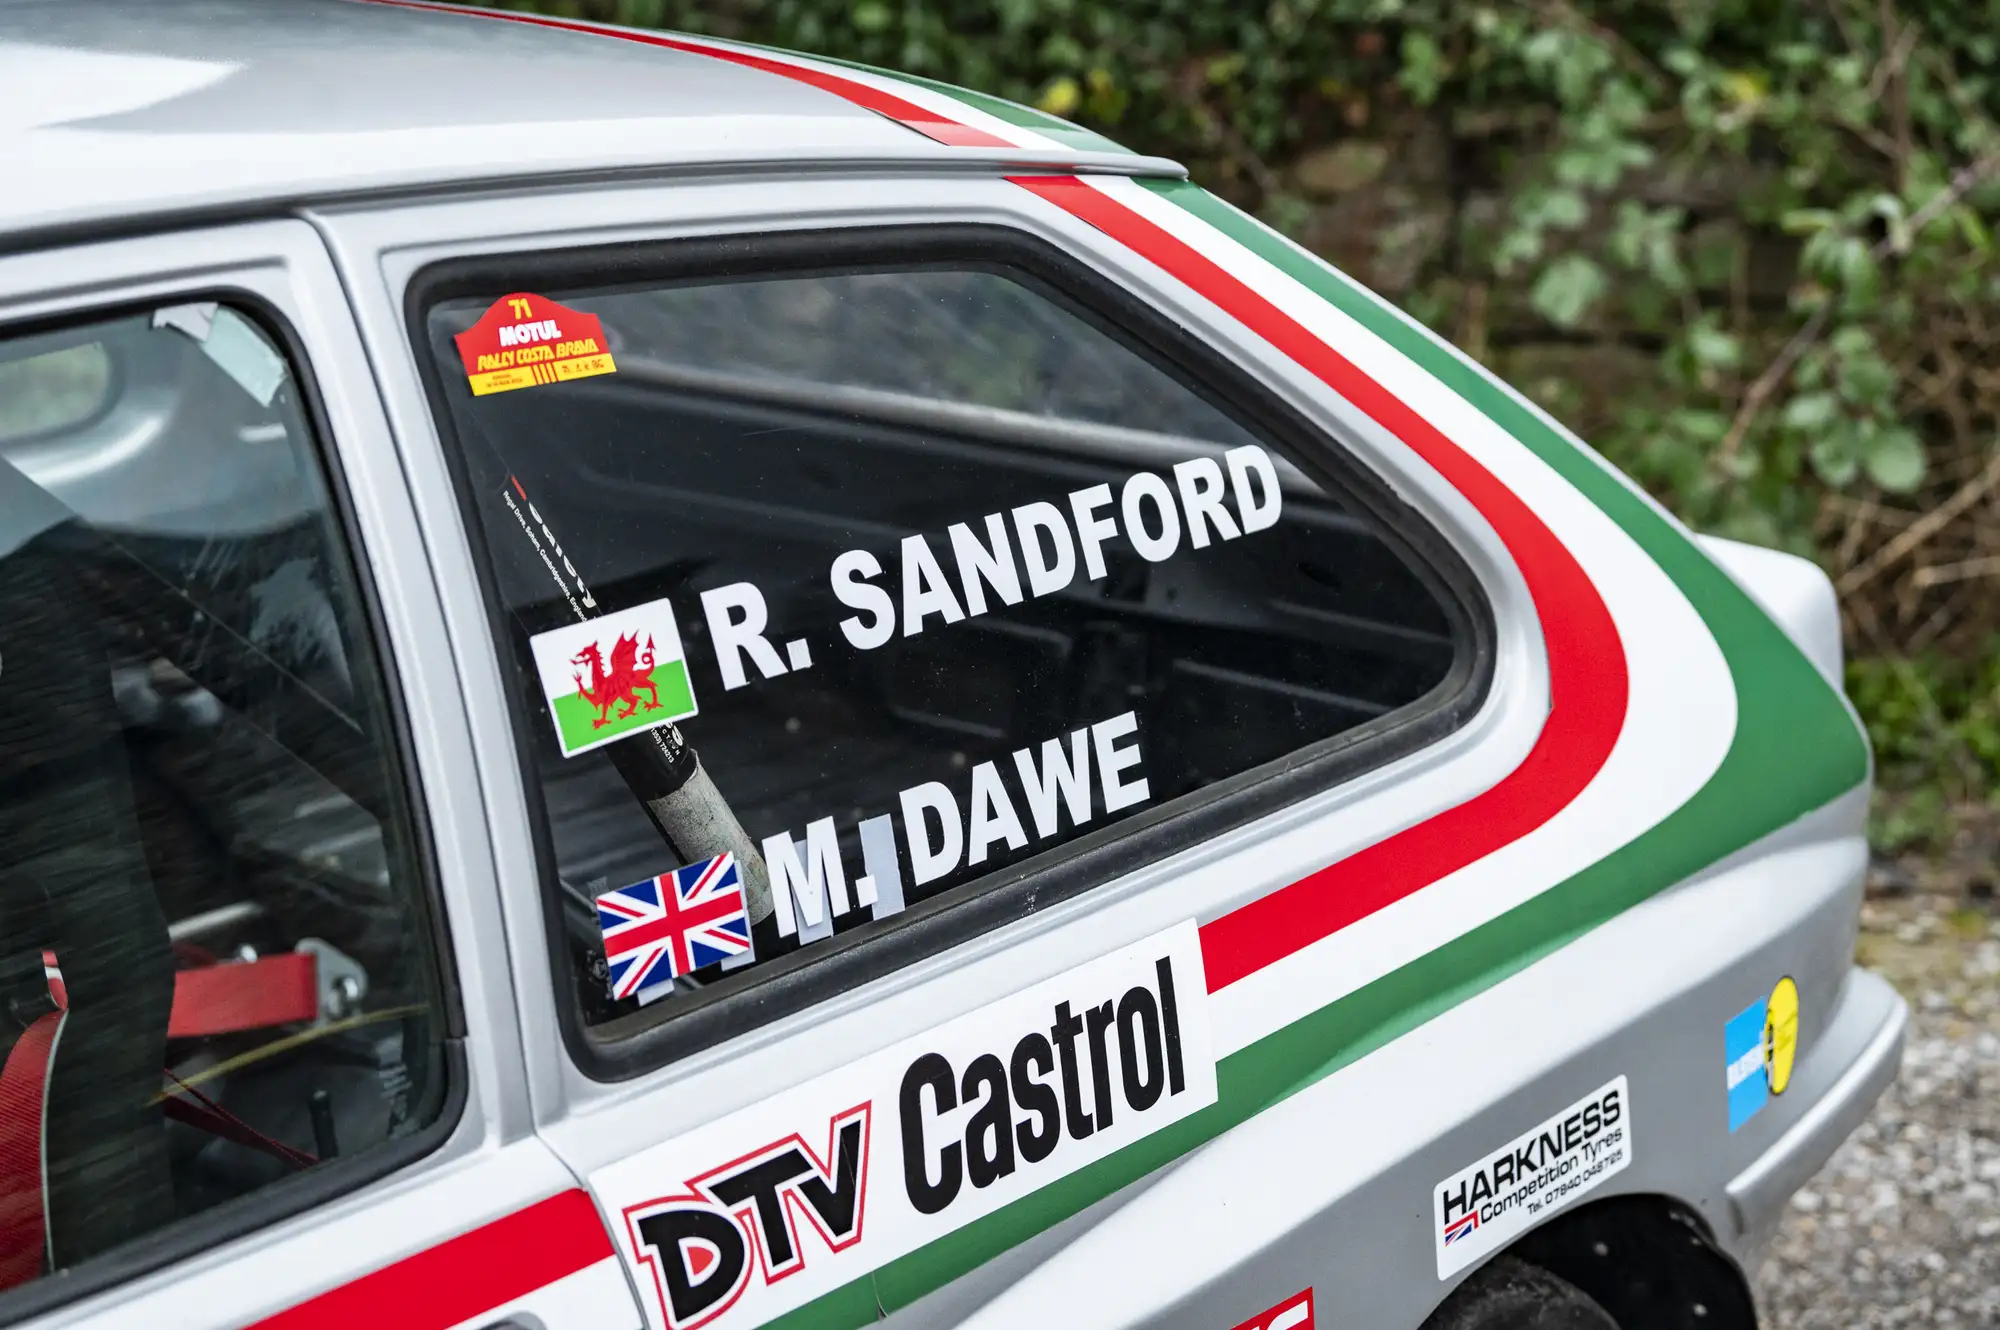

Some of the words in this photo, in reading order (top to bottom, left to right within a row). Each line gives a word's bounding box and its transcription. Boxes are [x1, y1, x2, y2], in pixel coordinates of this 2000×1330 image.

[498, 319, 562, 347] MOTUL
[508, 298, 533, 320] 71
[477, 349, 515, 372] RALLY
[515, 345, 555, 365] COSTA
[555, 338, 600, 359] BRAVA
[513, 507, 526, 529] Drive,
[524, 525, 541, 552] Soham,
[700, 581, 814, 692] R.
[829, 444, 1283, 651] SANDFORD
[760, 816, 879, 939] M.
[899, 710, 1150, 887] DAWE
[623, 1099, 872, 1330] DTV
[898, 955, 1186, 1215] Castrol
[1443, 1089, 1621, 1225] HARKNESS
[1480, 1155, 1579, 1225] Competition
[1582, 1127, 1623, 1165] Tyres
[1526, 1198, 1544, 1215] Tel.
[1545, 1175, 1583, 1204] 07840
